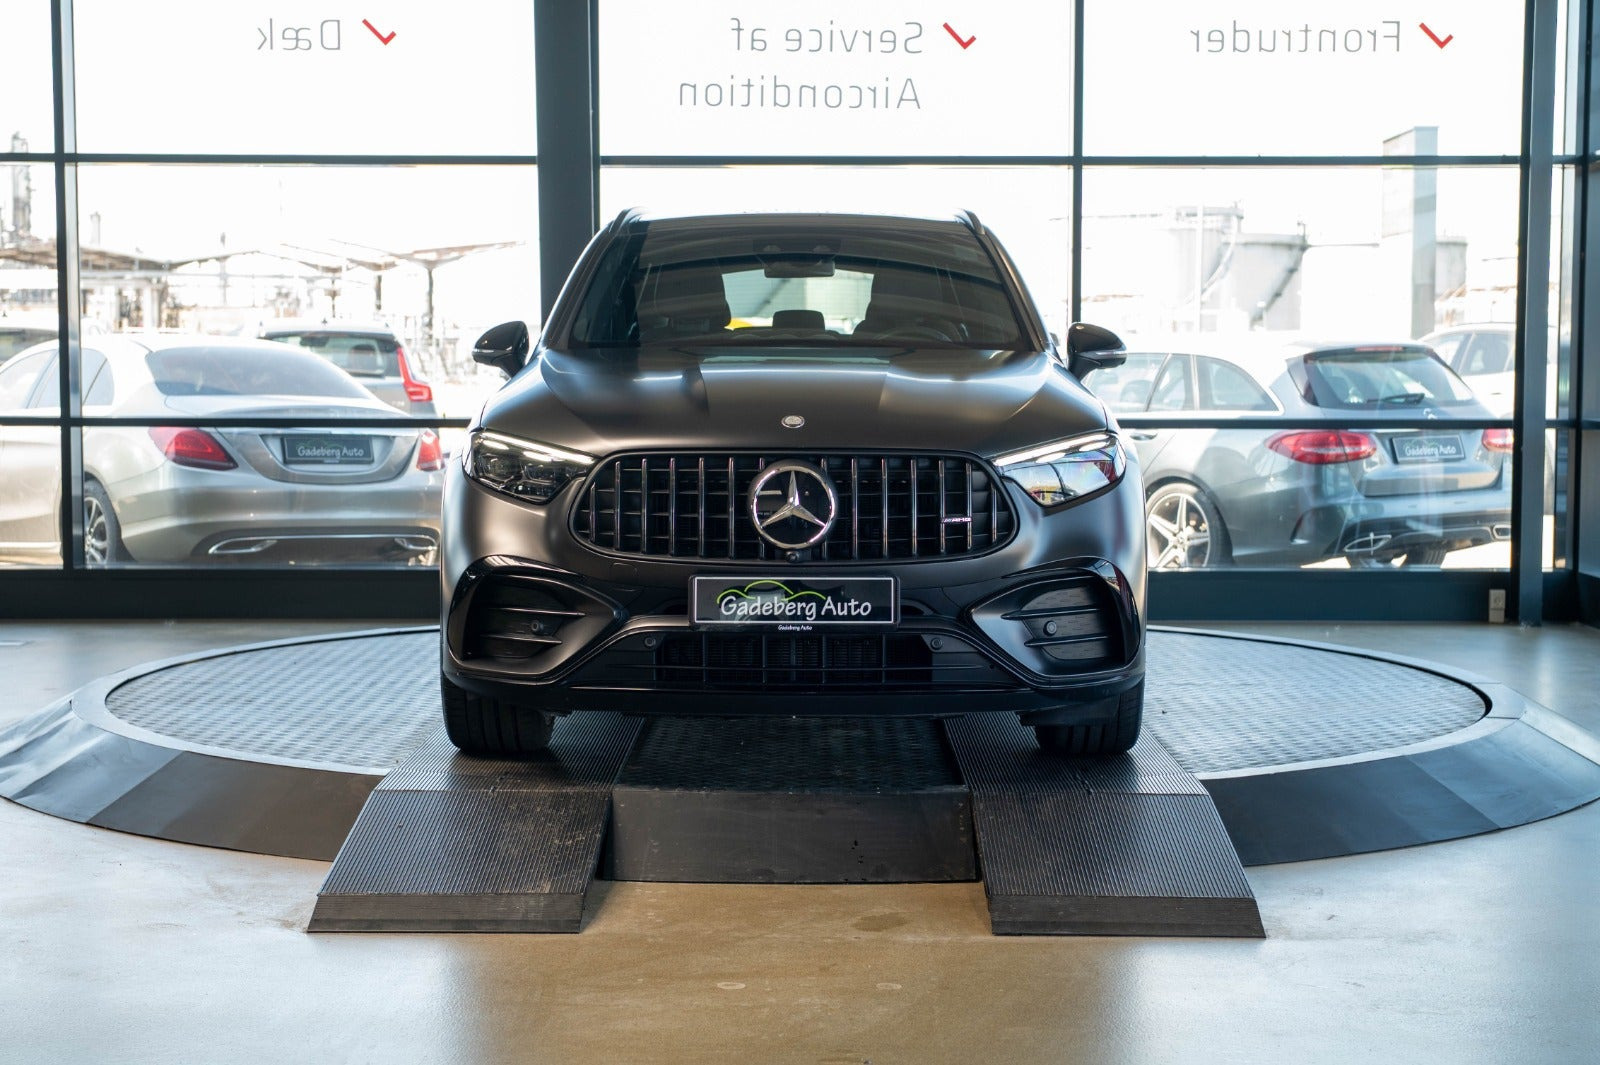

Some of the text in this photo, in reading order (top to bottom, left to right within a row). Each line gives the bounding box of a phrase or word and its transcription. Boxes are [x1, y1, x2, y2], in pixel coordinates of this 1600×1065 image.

[297, 446, 364, 459] Gadeberg Auto
[720, 596, 872, 621] Gadeberg Auto
